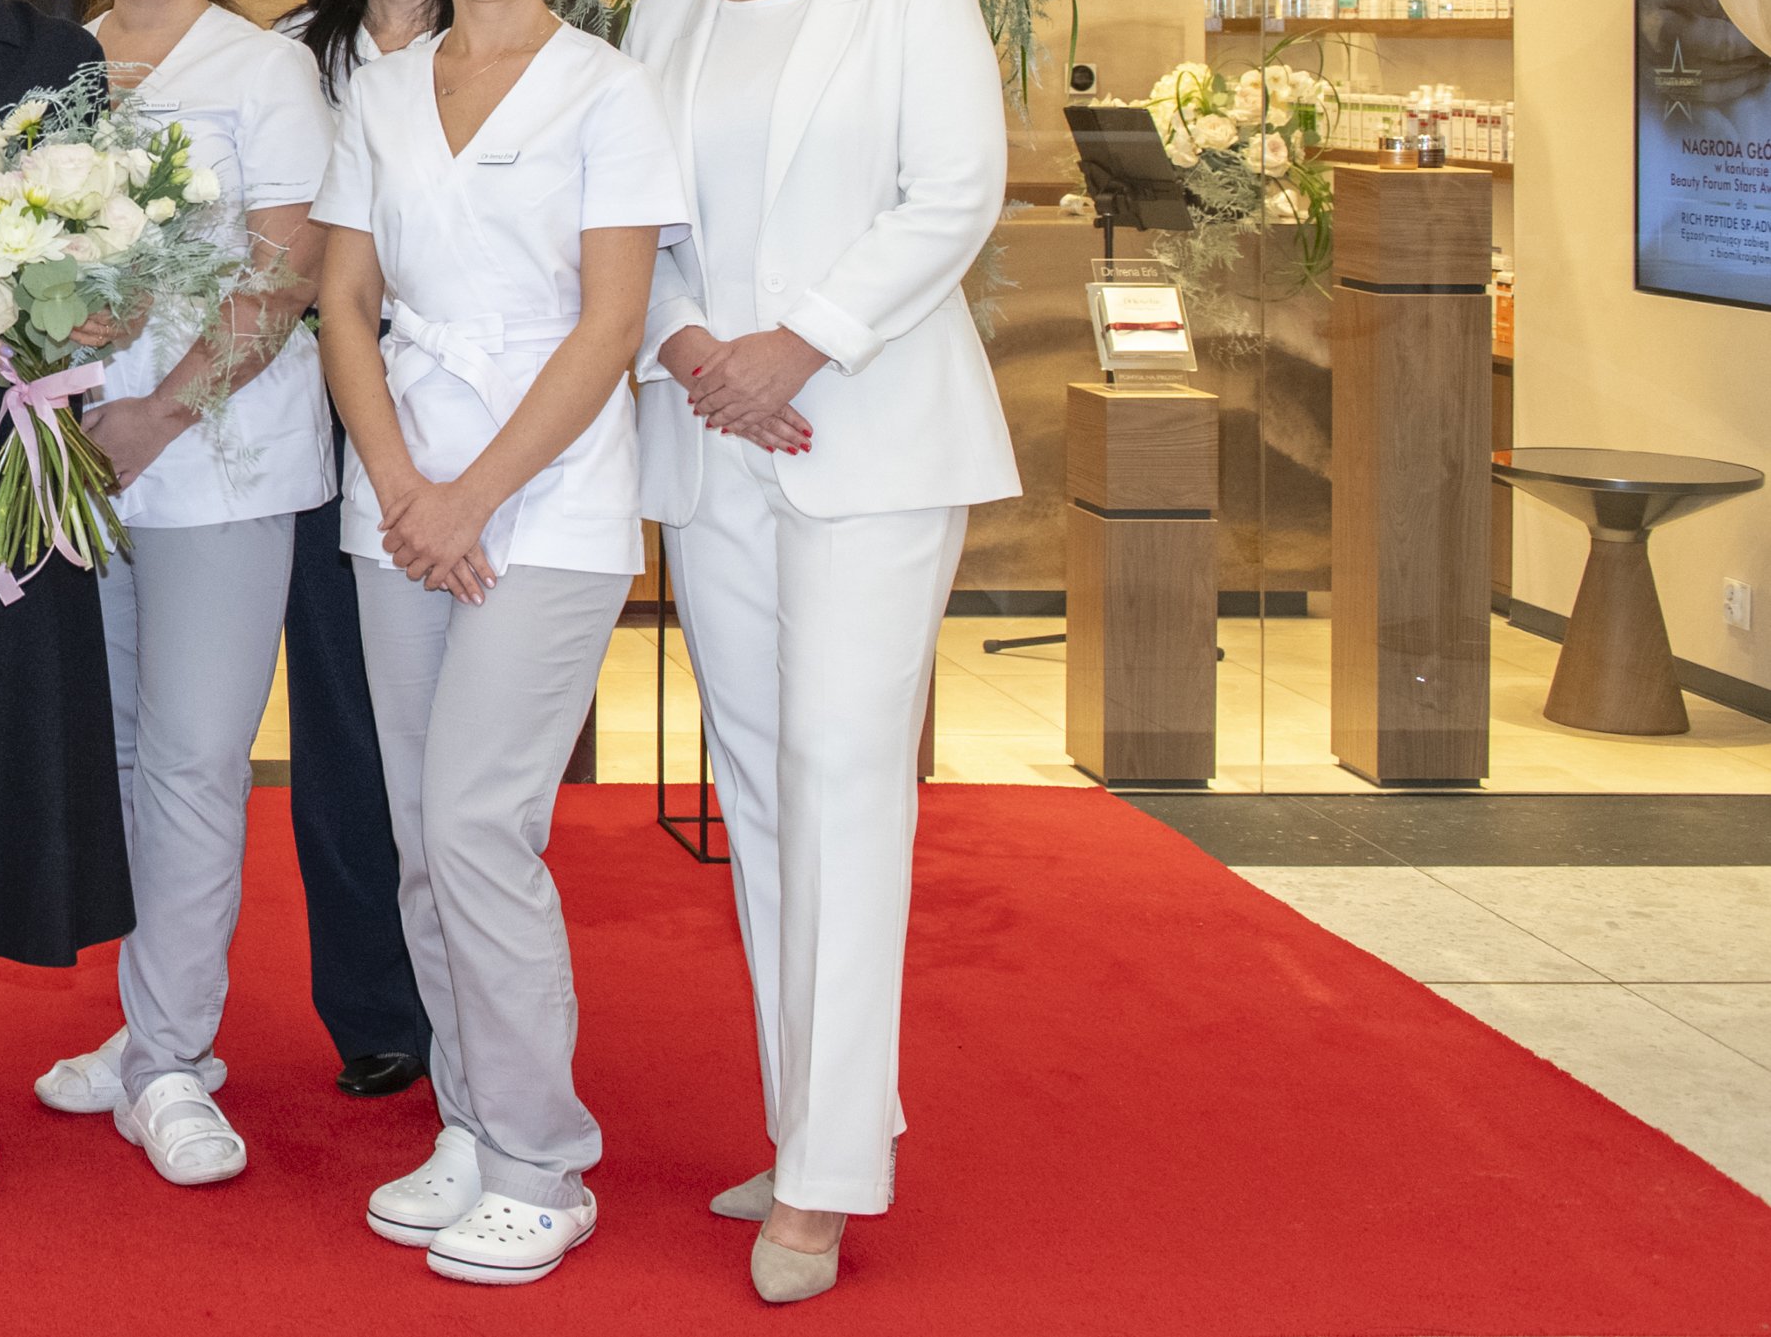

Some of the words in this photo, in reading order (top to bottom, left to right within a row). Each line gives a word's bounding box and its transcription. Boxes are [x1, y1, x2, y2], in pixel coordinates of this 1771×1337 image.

[1682, 138, 1743, 158] NAGRODA
[1725, 160, 1769, 177] konkursie
[1670, 173, 1700, 191] Beauty
[1702, 175, 1731, 191] Forum
[1734, 178, 1757, 193] Stars
[1681, 212, 1701, 225] RICH
[1704, 214, 1738, 230] PEPTIDE
[1100, 266, 1114, 276] Dr
[1116, 267, 1140, 277] Irena
[1141, 267, 1158, 277] Eris
